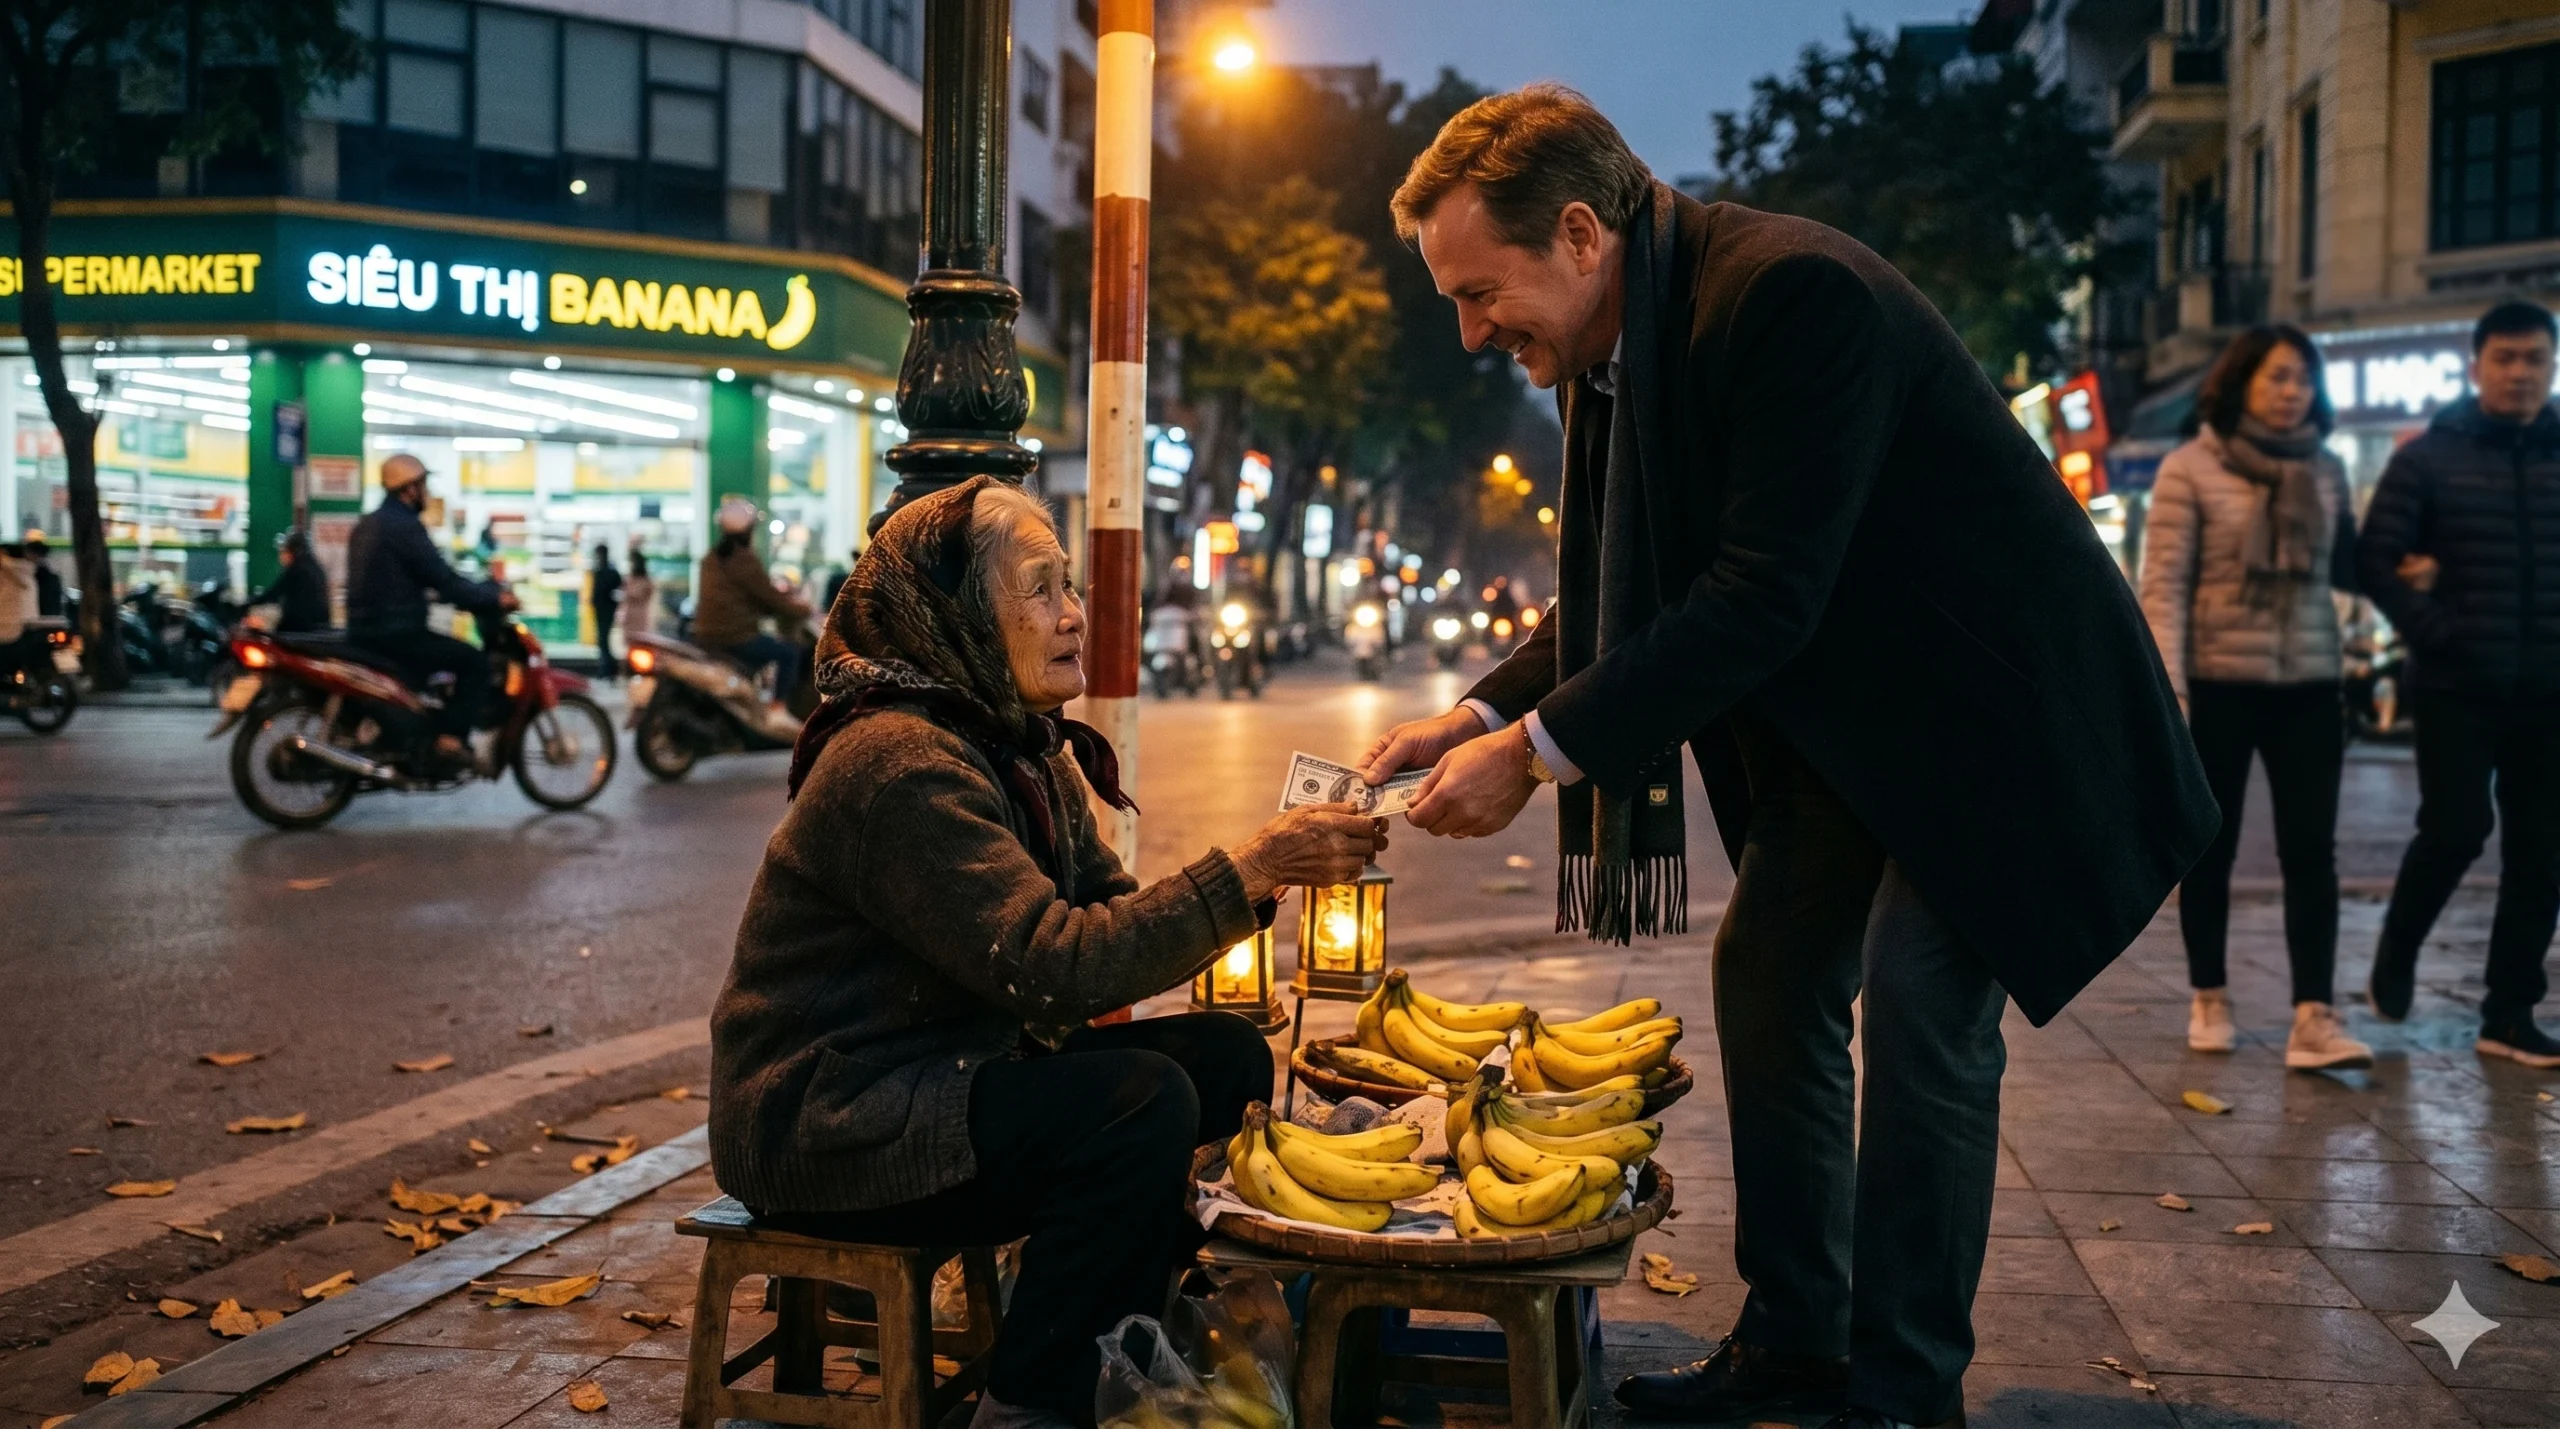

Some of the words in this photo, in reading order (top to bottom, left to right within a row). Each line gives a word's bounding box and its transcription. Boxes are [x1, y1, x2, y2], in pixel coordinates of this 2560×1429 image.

[0, 253, 262, 297] SPERMARKET
[306, 243, 439, 312] SIÊU
[449, 263, 540, 333] THỊ
[550, 272, 768, 340] BANANA
